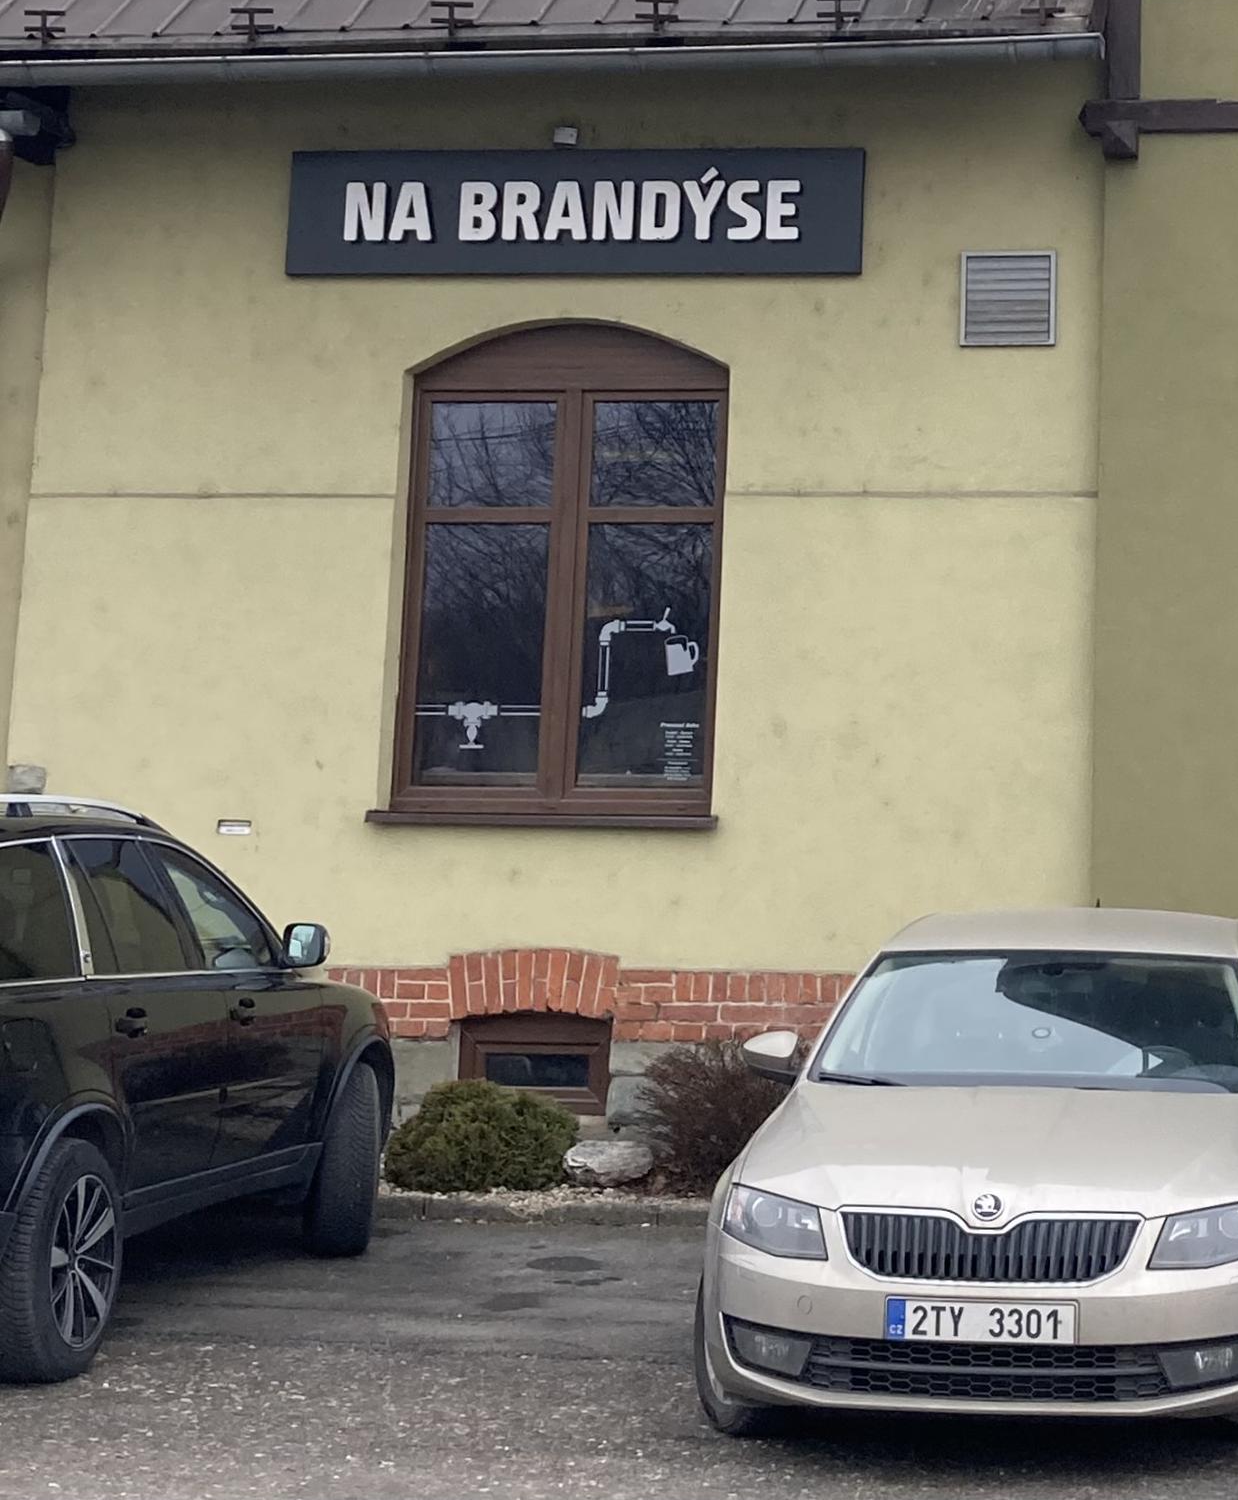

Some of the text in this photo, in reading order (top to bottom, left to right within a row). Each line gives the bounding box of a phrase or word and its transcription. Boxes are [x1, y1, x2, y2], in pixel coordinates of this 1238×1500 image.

[343, 166, 801, 242] NA BRANDÝSE
[889, 1324, 903, 1335] CZ
[911, 1305, 1060, 1340] 2TY 3301
